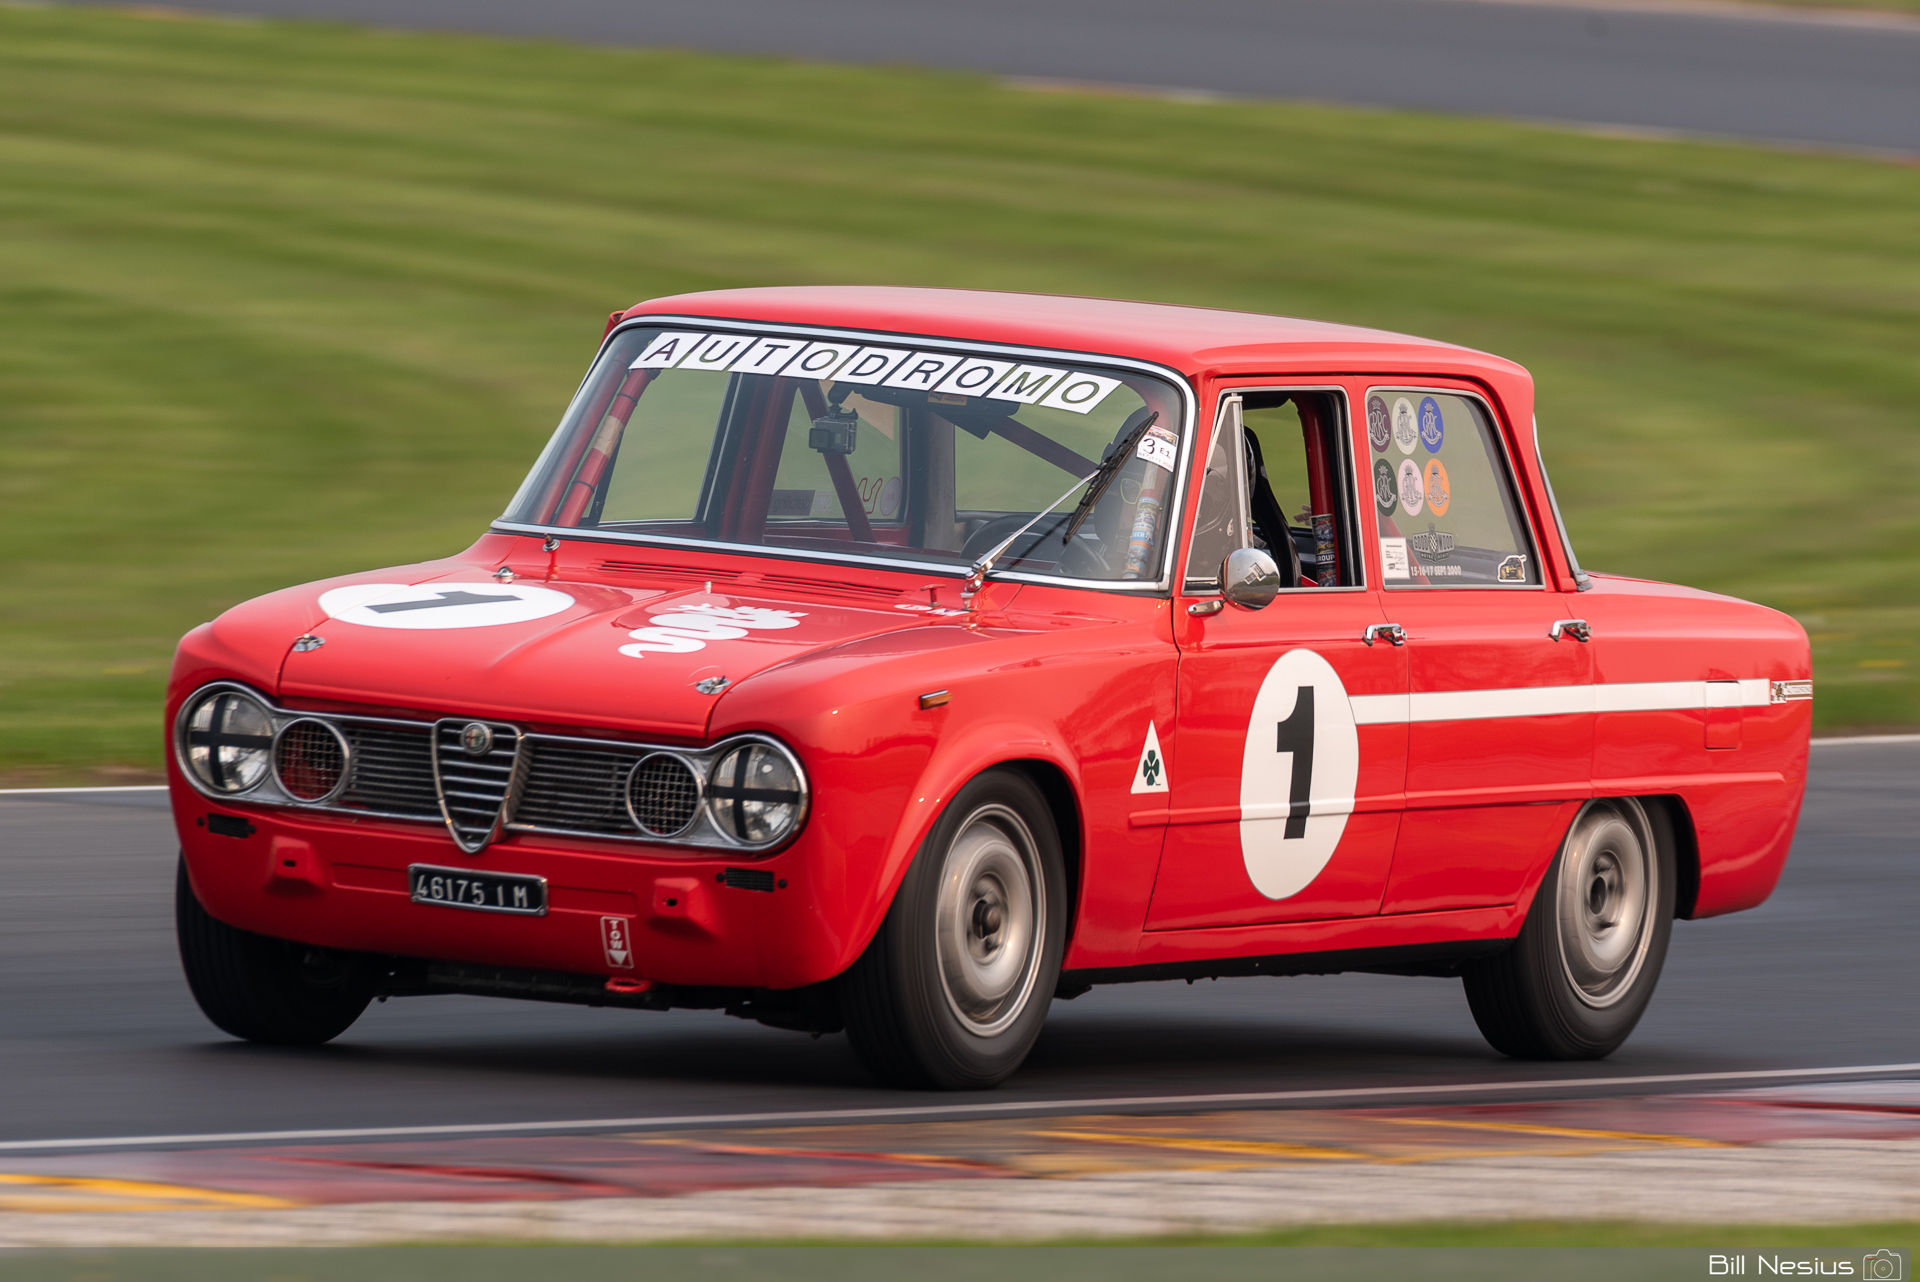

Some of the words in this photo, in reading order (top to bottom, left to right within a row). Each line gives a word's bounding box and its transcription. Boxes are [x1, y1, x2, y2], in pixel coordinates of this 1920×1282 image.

[643, 338, 1100, 404] AUTODROMO
[1142, 438, 1156, 454] 3
[365, 590, 524, 614] 1
[1277, 686, 1315, 840] 1
[415, 874, 485, 905] 46175
[609, 920, 623, 950] TOW
